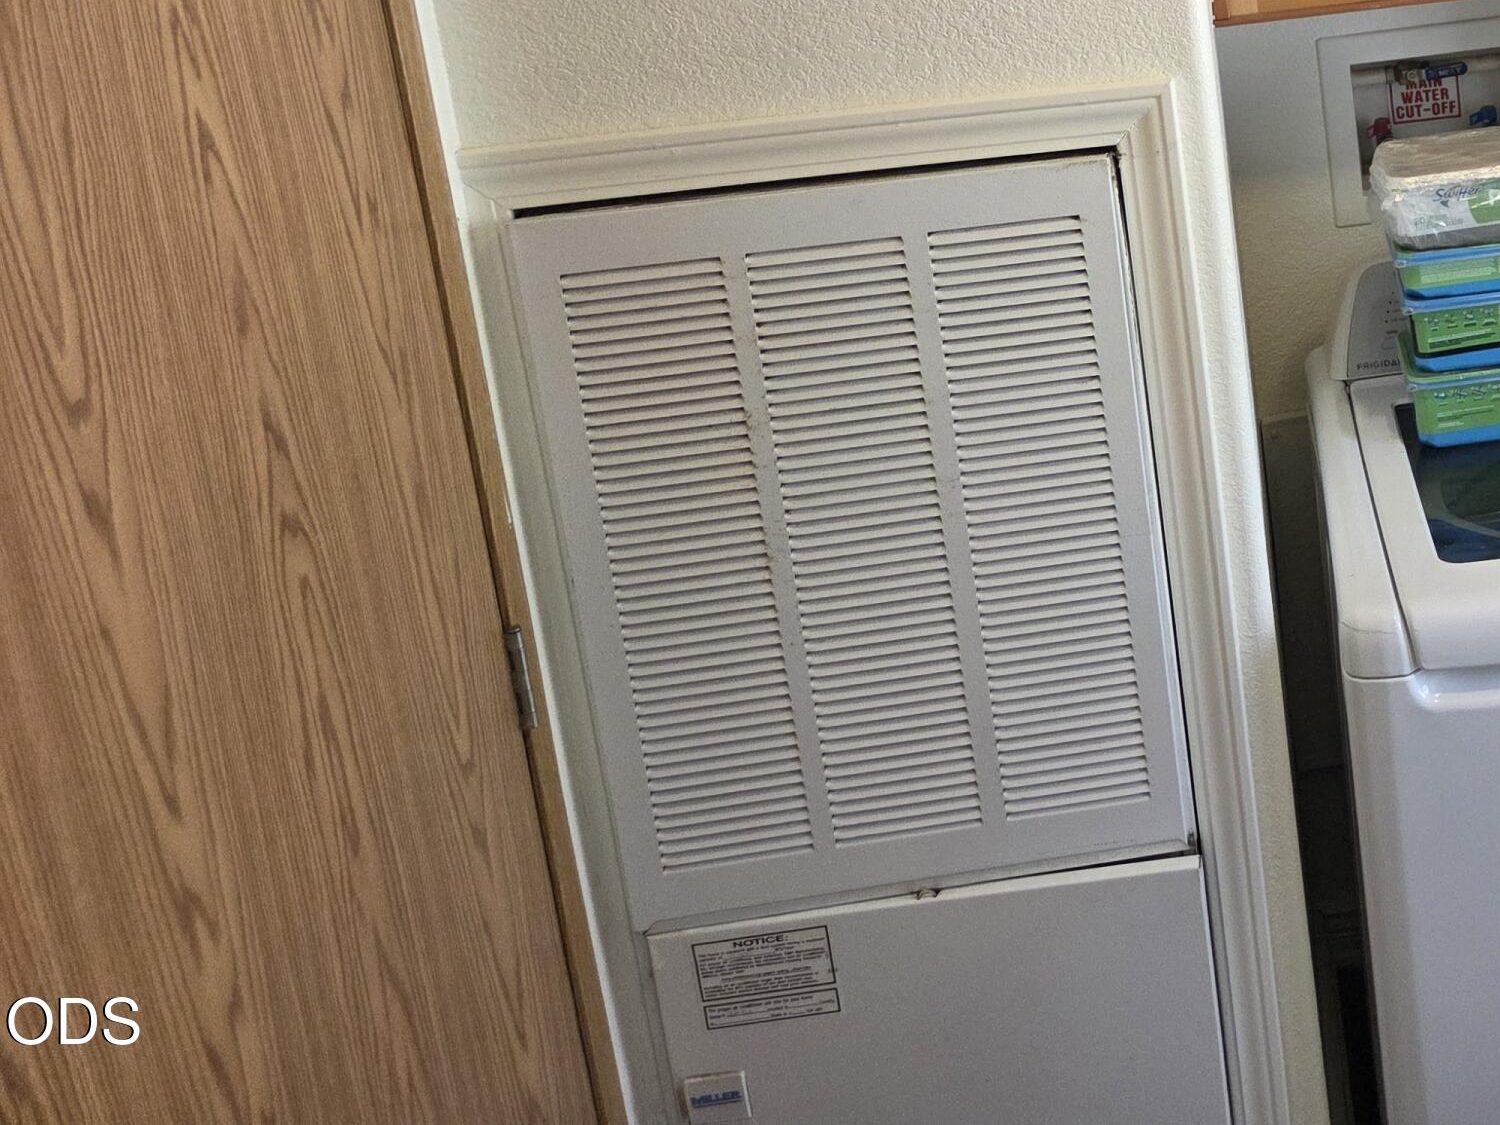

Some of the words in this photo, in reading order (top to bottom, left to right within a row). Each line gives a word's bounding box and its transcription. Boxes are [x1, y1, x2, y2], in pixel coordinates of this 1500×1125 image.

[1406, 78, 1443, 90] MAIN
[1401, 87, 1449, 104] WATER
[1396, 101, 1456, 119] CUT-OFF
[1435, 186, 1480, 203] Swiffer
